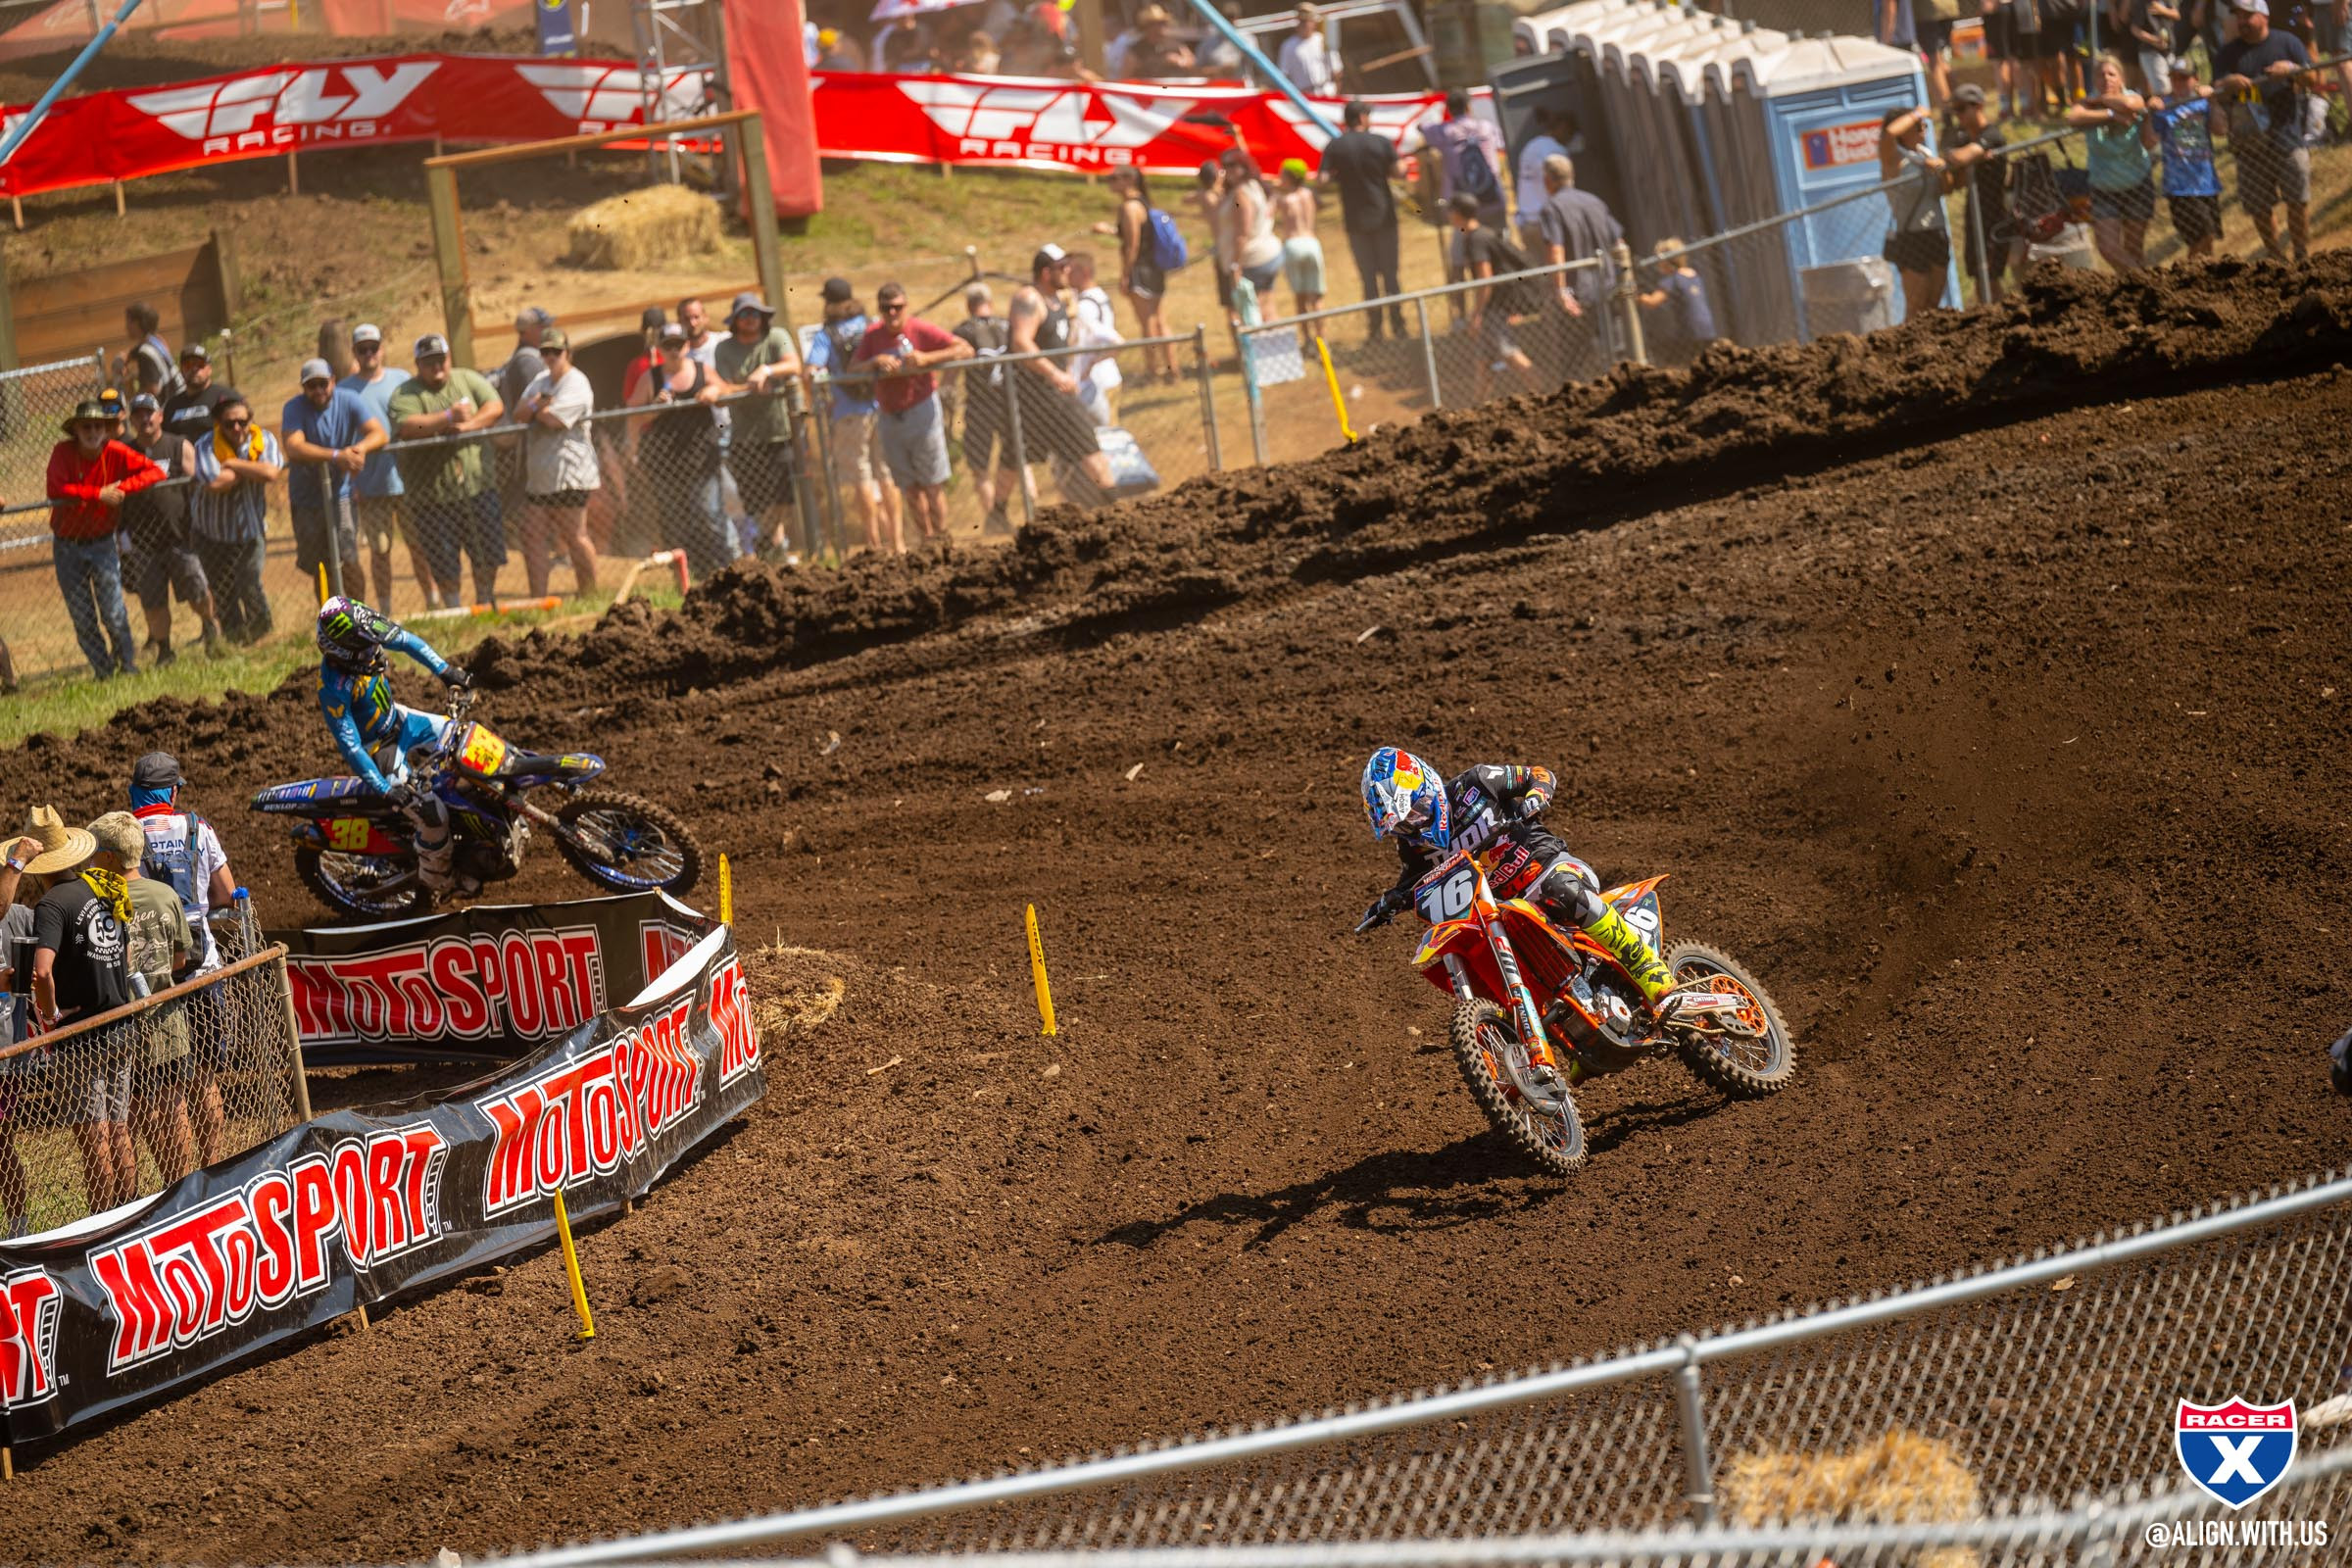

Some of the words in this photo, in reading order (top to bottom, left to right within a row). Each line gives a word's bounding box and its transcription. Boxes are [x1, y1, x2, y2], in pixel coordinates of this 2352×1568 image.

[150, 839, 186, 850] PTAIN
[328, 817, 369, 851] 38
[1489, 868, 1506, 889] ed
[1500, 845, 1531, 879] Bull
[1421, 869, 1474, 926] 16
[286, 933, 599, 1039] MOTOSPORT
[481, 1004, 698, 1211] MOTOSPORT
[91, 1125, 445, 1368] MOTOSPORT
[58, 1374, 70, 1388] TM
